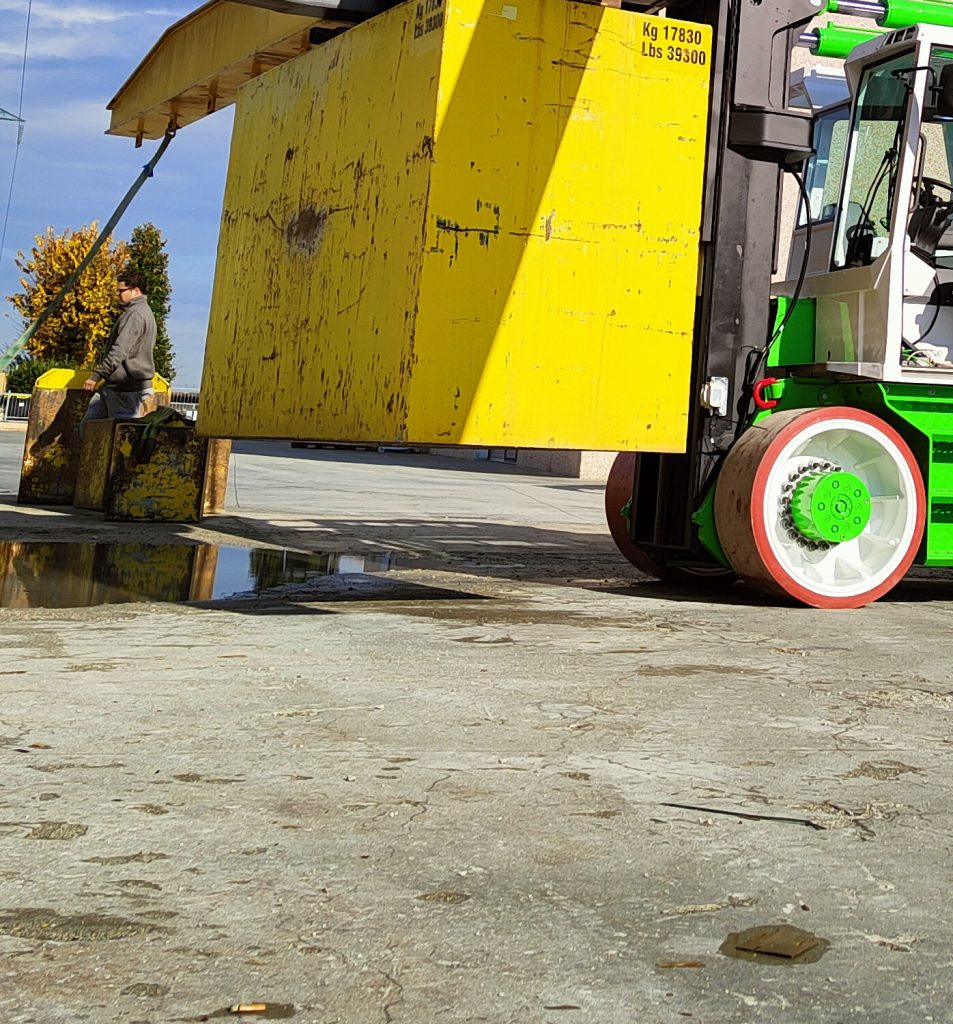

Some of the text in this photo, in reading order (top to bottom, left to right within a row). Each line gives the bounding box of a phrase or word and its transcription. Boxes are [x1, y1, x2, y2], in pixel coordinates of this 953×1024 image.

[643, 21, 702, 46] Kg 17830
[641, 41, 706, 66] Lbs 39300
